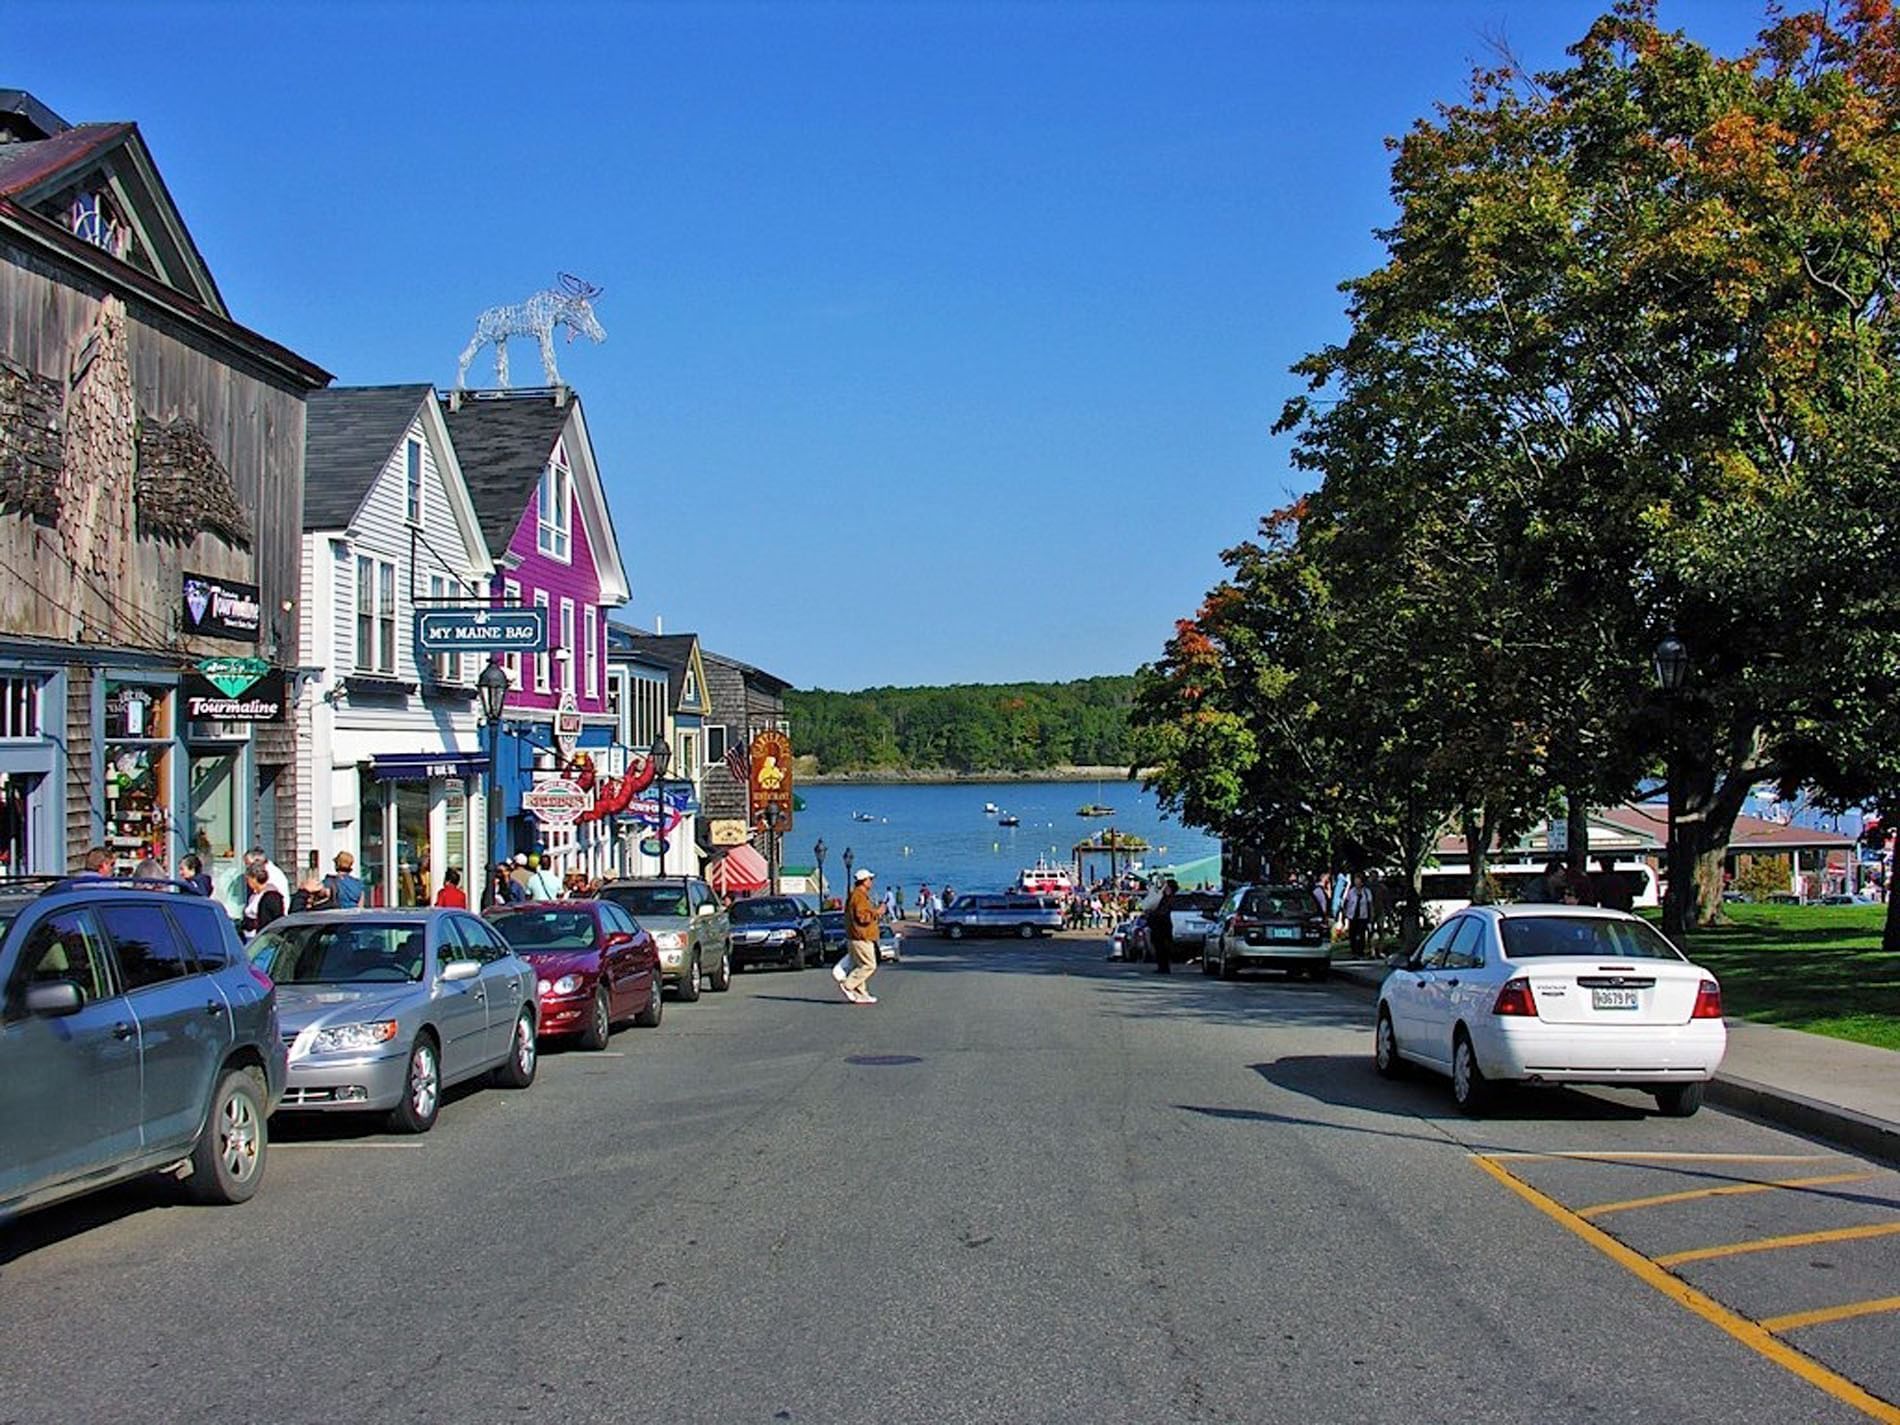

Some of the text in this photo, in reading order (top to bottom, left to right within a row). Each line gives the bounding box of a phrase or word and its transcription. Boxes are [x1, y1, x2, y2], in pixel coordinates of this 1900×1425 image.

[428, 626, 534, 640] MY MAINE BAG
[188, 696, 279, 716] Tourmaline
